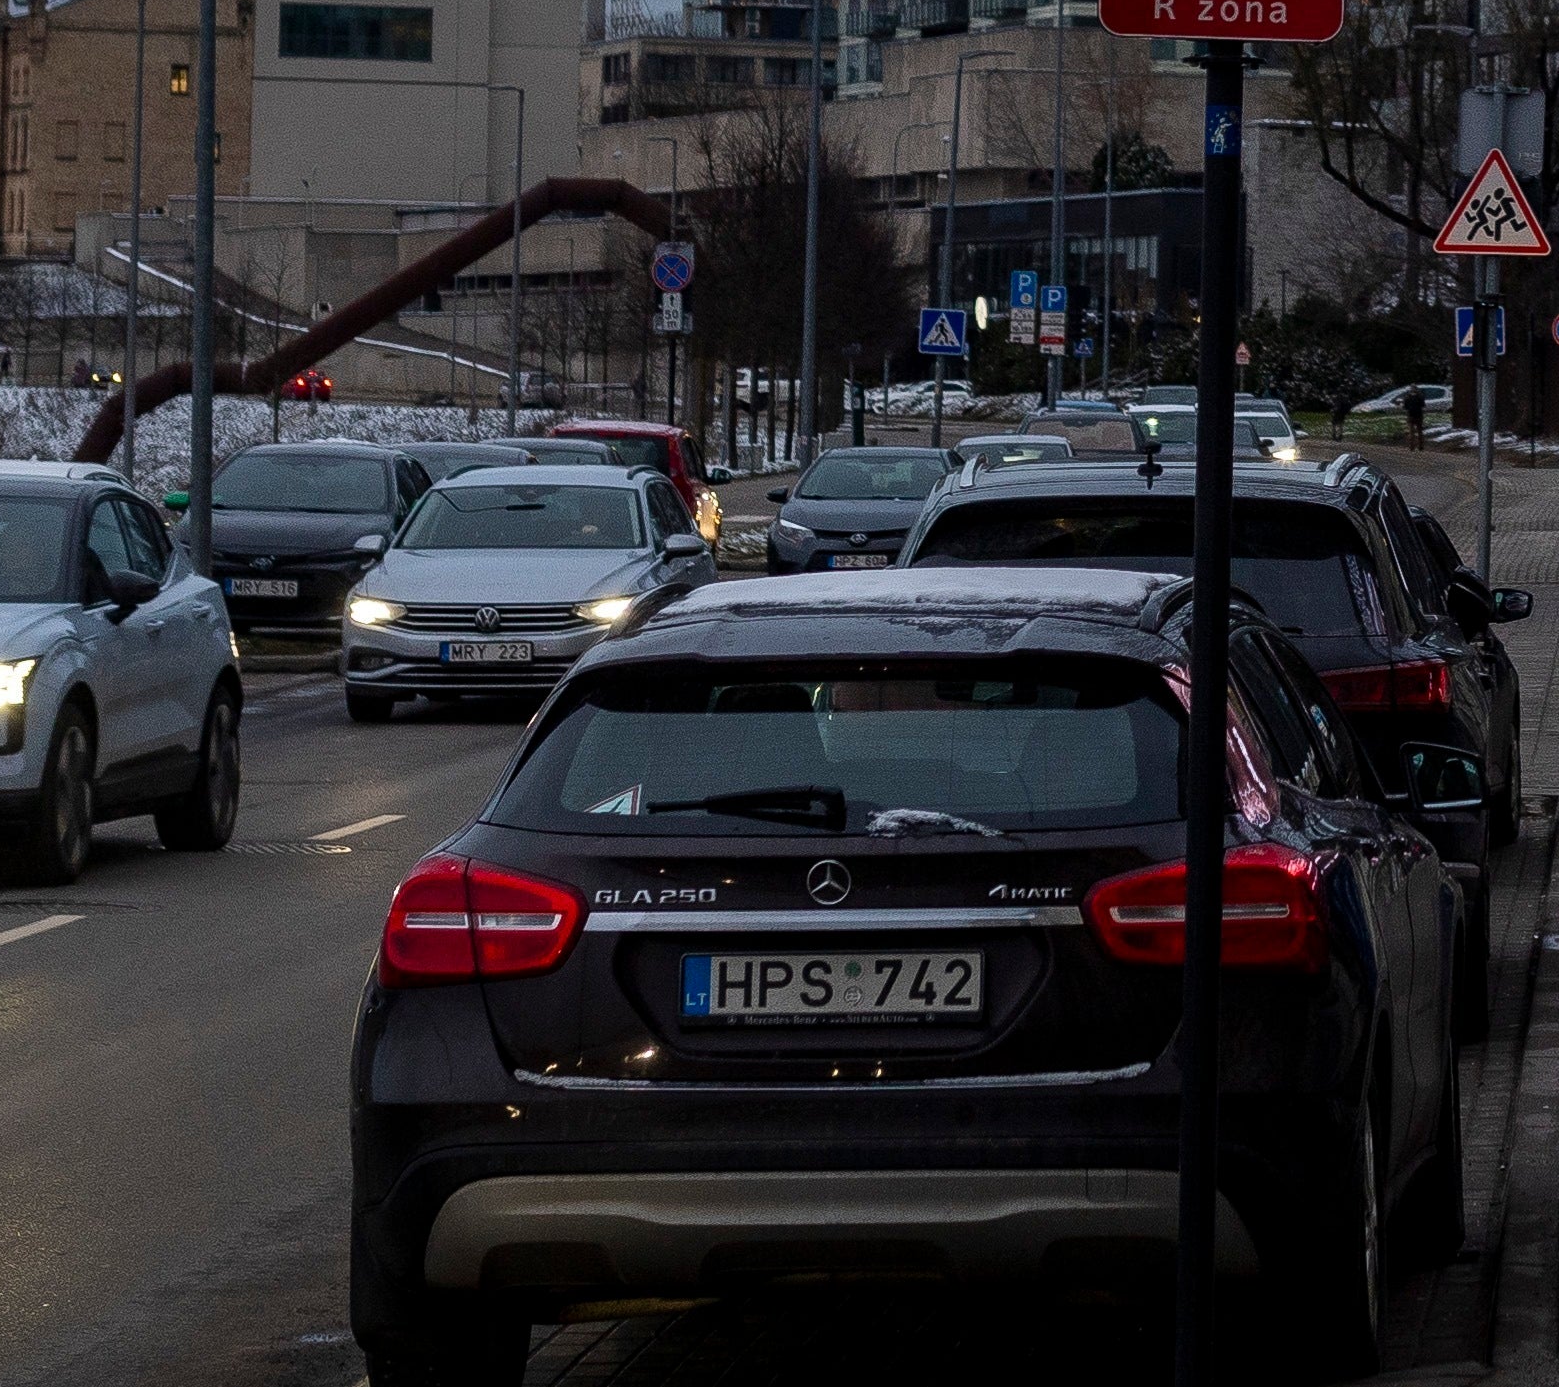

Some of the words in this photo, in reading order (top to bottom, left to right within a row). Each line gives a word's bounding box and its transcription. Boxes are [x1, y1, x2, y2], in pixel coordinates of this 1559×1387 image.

[1198, 0, 1288, 24] zona
[1018, 274, 1032, 291] P
[1048, 289, 1061, 308] P
[664, 309, 679, 320] 50
[450, 643, 485, 659] MRY
[499, 643, 529, 659] 223
[595, 889, 652, 904] GLA
[660, 888, 717, 903] 250
[686, 993, 707, 1006] LT
[717, 960, 834, 1009] HPS
[874, 958, 973, 1007] 742
